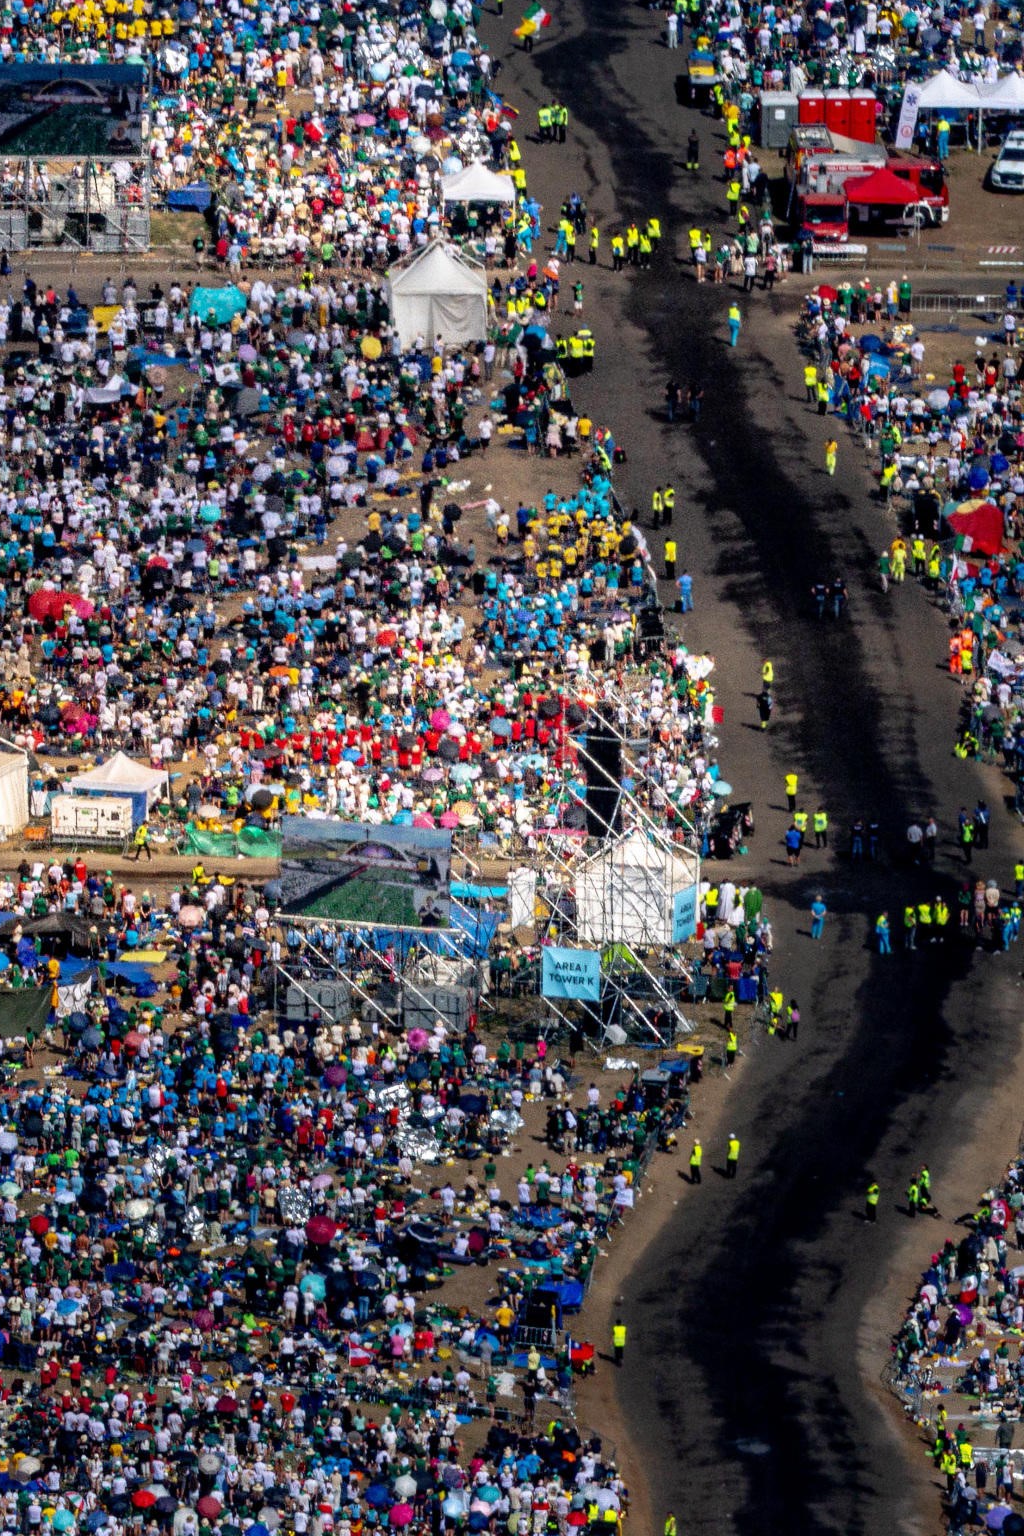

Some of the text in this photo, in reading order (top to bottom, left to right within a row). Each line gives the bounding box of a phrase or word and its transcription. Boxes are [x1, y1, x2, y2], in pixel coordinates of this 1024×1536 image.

[555, 961, 582, 973] AREA
[549, 972, 594, 986] TOWER K
